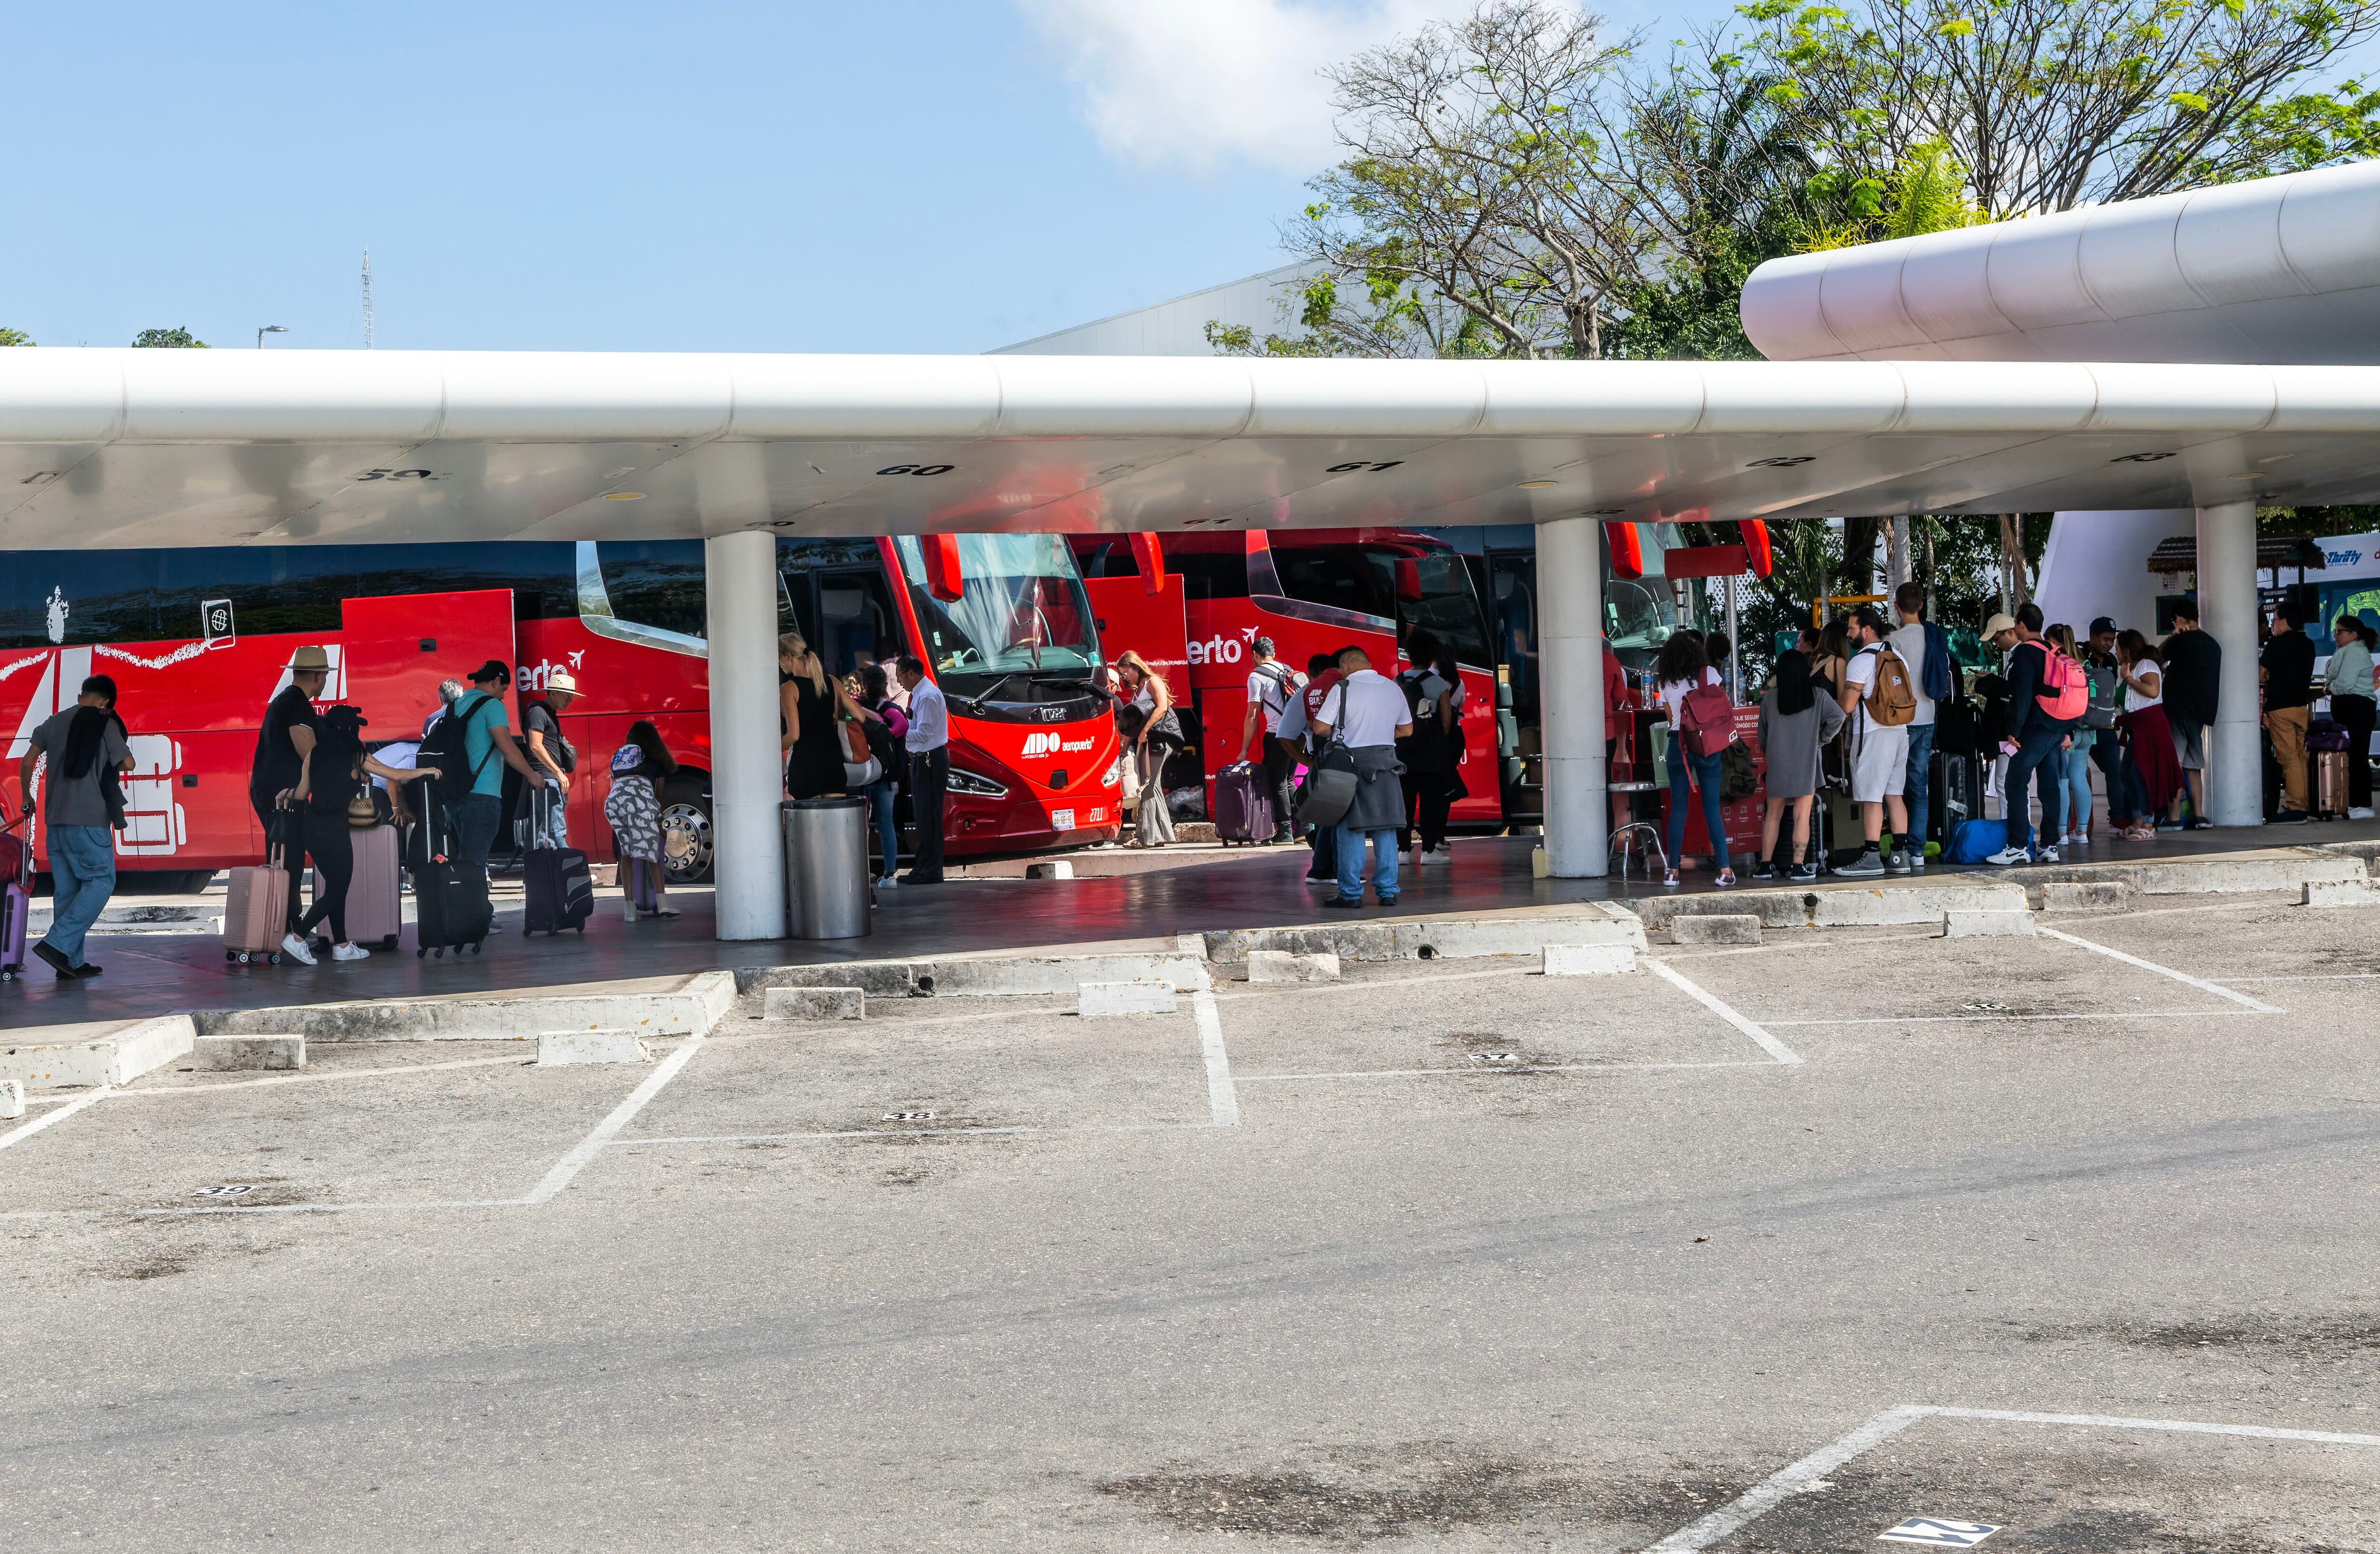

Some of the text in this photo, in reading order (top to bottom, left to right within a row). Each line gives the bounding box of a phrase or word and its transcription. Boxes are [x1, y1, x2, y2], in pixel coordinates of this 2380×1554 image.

[1326, 461, 1405, 472] 61
[1745, 457, 1817, 467] 62
[876, 465, 955, 476] 60
[2327, 550, 2362, 566] Thrifty
[1021, 732, 1092, 755] ADO aeropuerto
[1090, 807, 1103, 822] 2711
[196, 1185, 252, 1195] 39
